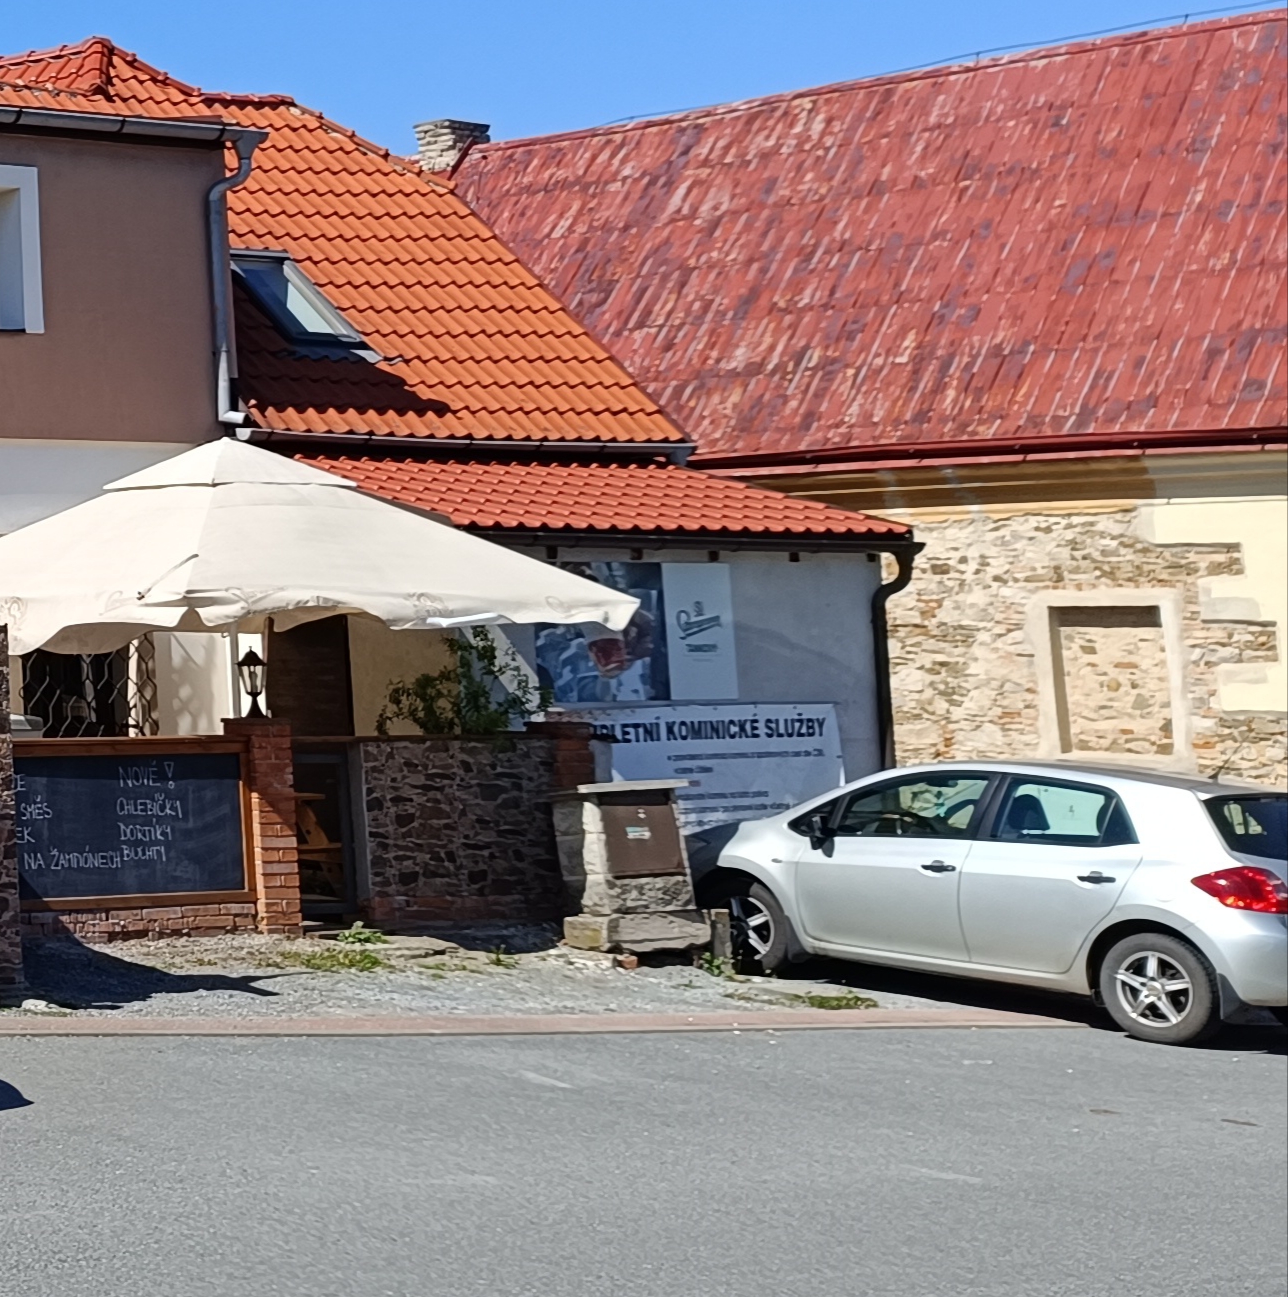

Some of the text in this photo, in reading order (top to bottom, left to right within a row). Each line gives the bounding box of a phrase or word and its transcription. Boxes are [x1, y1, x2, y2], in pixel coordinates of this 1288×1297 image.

[666, 713, 760, 742] KOMINICKÉ
[764, 712, 826, 738] SLUŽBY
[20, 795, 53, 820] SMĚS
[116, 793, 182, 818] CHLEBÍČKY
[23, 852, 46, 870] NA
[121, 845, 166, 862] BUCHTY
